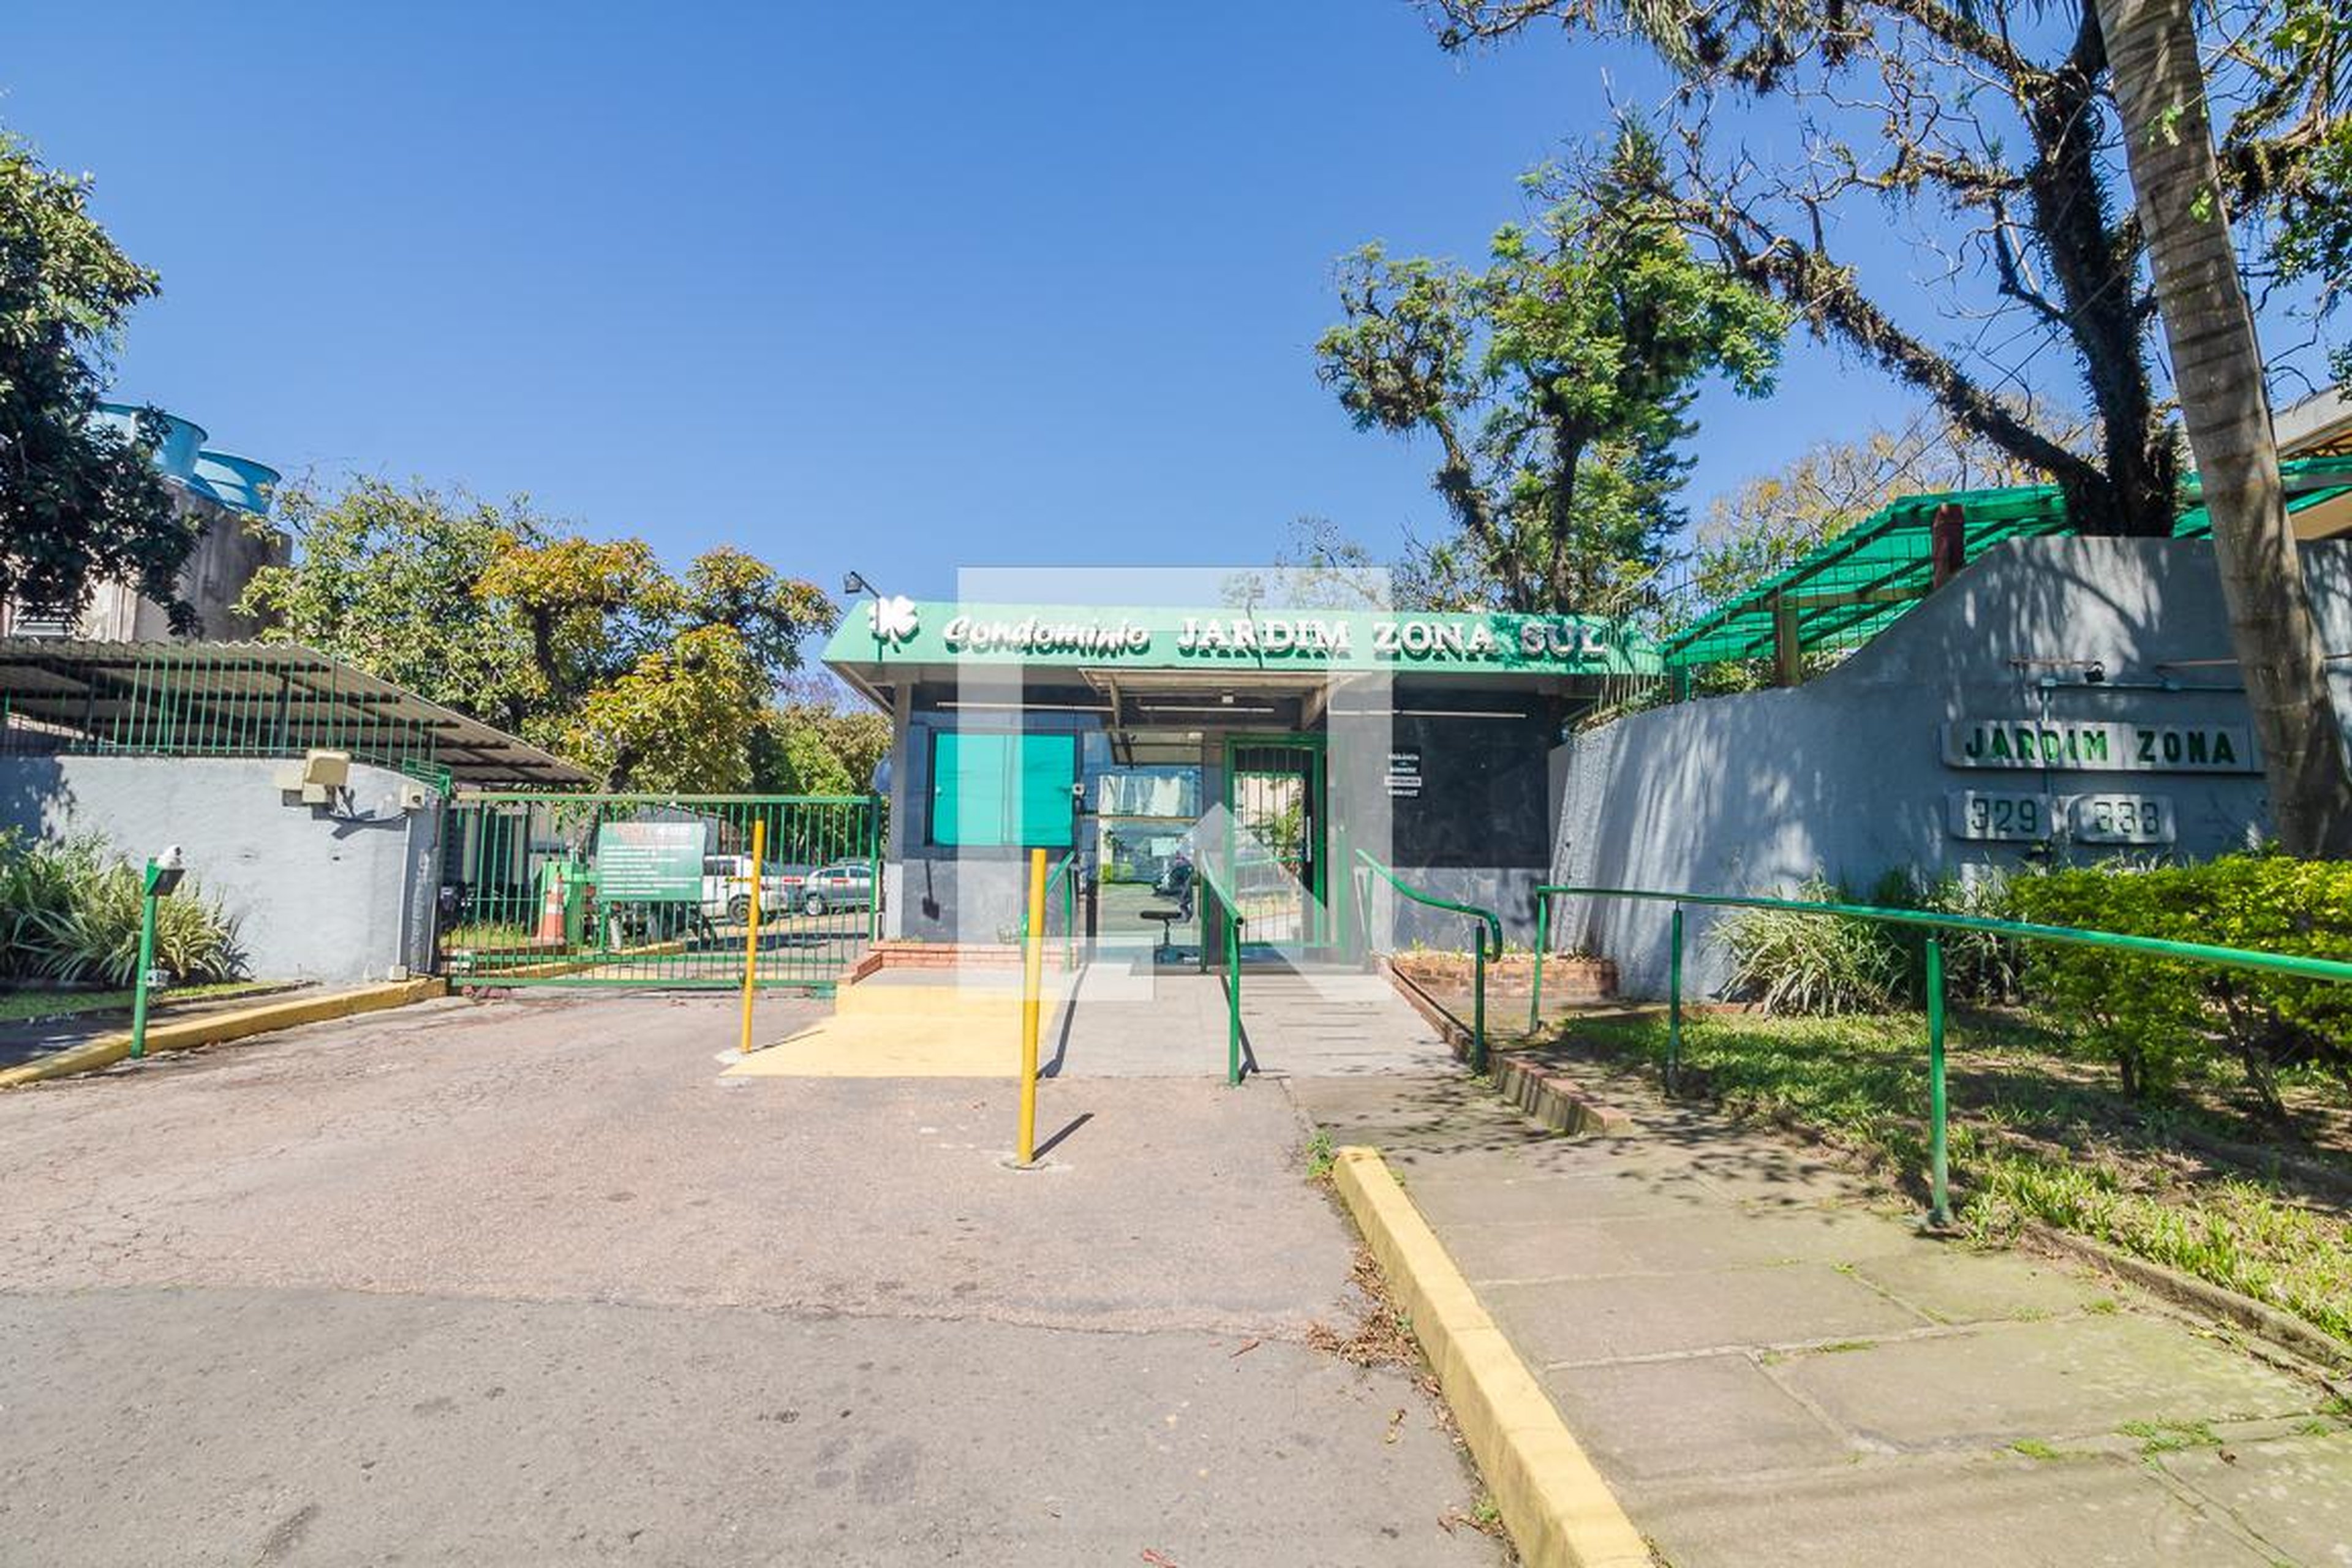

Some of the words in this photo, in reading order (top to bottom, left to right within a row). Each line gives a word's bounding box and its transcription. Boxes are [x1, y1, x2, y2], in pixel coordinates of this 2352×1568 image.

[1177, 618, 1351, 653] JARDIM
[1373, 621, 1497, 655] ZONA
[1521, 622, 1608, 655] SUL
[1965, 727, 2108, 761] JARDIM
[2137, 730, 2236, 764] ZONA
[1971, 797, 2037, 833] 329
[2094, 801, 2160, 835] 333
